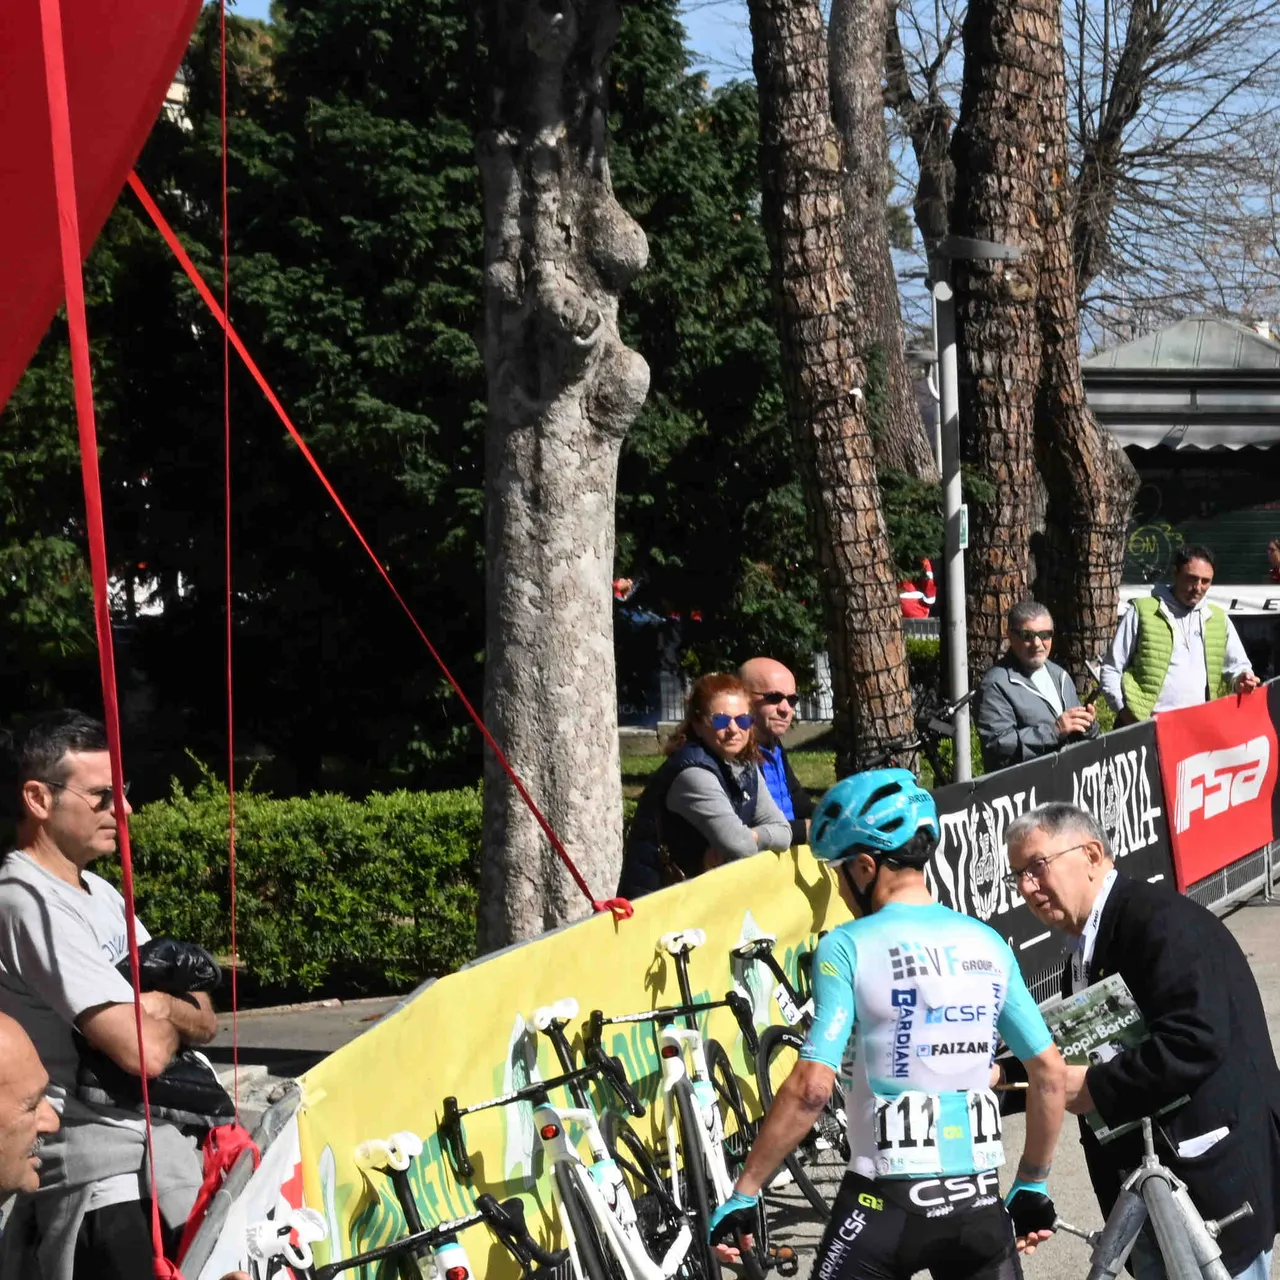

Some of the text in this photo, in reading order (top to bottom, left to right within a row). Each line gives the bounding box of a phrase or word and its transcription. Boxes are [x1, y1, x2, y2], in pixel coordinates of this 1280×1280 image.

[777, 993, 796, 1021] 113
[944, 1006, 987, 1021] CSF
[909, 1170, 998, 1207] CSF
[839, 1209, 867, 1241] CSF
